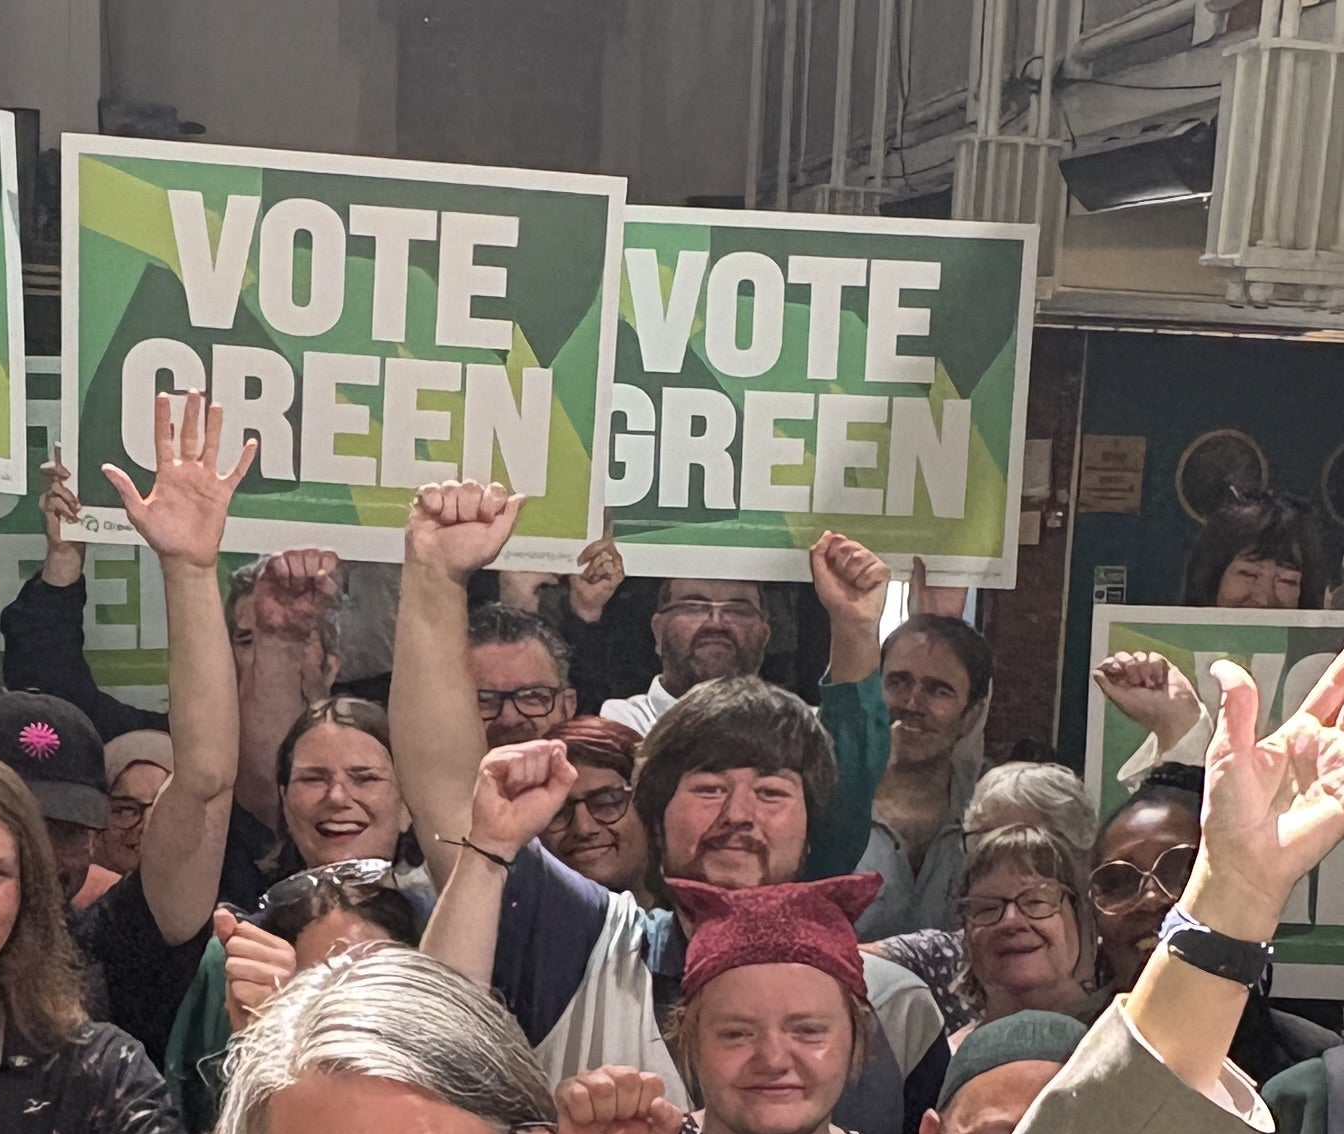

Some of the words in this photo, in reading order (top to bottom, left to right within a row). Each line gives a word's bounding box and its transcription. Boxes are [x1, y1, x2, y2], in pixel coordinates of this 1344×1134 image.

[167, 189, 519, 350] VOTE
[624, 247, 941, 384] VOTE
[121, 337, 552, 496] GREEN
[605, 382, 971, 519] GREEN
